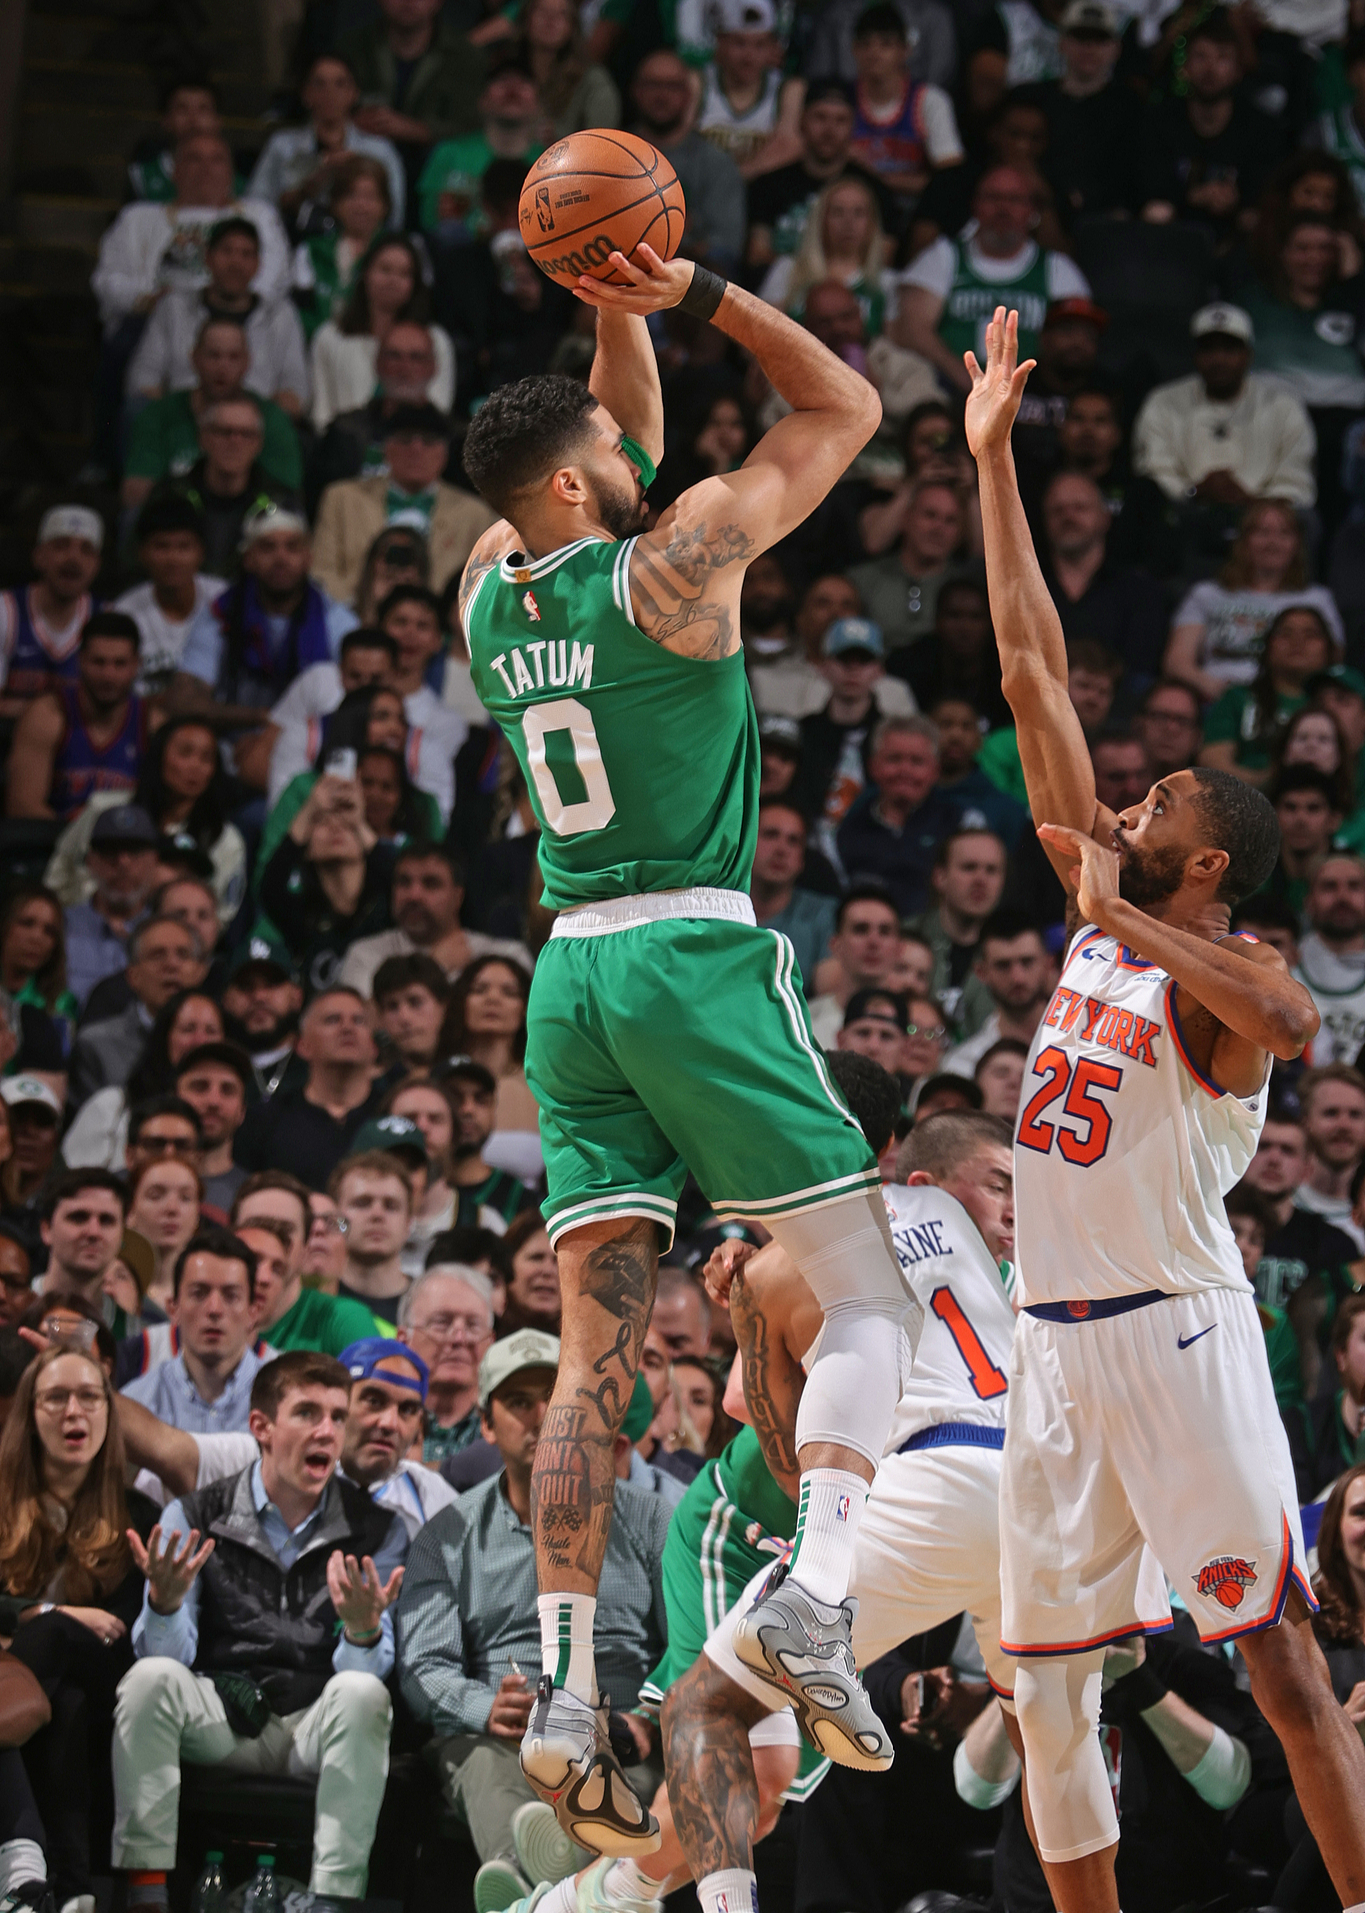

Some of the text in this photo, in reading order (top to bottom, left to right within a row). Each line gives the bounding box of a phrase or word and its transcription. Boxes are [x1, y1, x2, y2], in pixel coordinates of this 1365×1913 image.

[489, 639, 595, 700] TATUM
[522, 697, 616, 836] 0
[1080, 997, 1164, 1069] YORK
[1016, 1045, 1124, 1168] 25
[893, 1220, 953, 1268] AYNE
[930, 1284, 1008, 1401] 1
[1197, 1558, 1258, 1593] KNICKS
